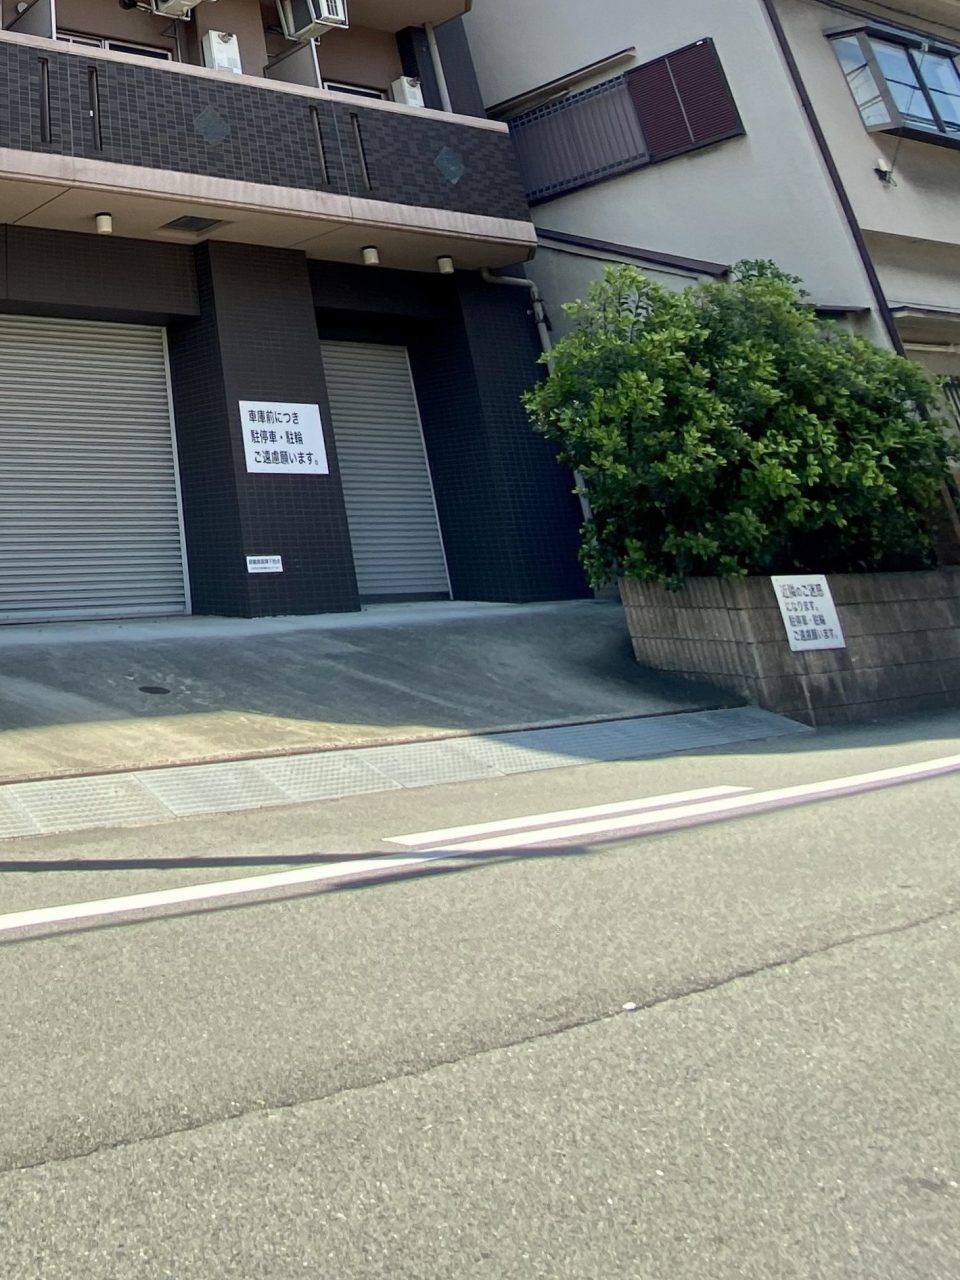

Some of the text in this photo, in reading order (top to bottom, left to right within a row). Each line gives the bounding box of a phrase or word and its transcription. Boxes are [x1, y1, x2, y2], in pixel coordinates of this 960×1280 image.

[248, 410, 300, 425] 車庫前につき
[251, 430, 304, 445] 駐停車・駐輪
[254, 451, 319, 466] ご遠慮願います。
